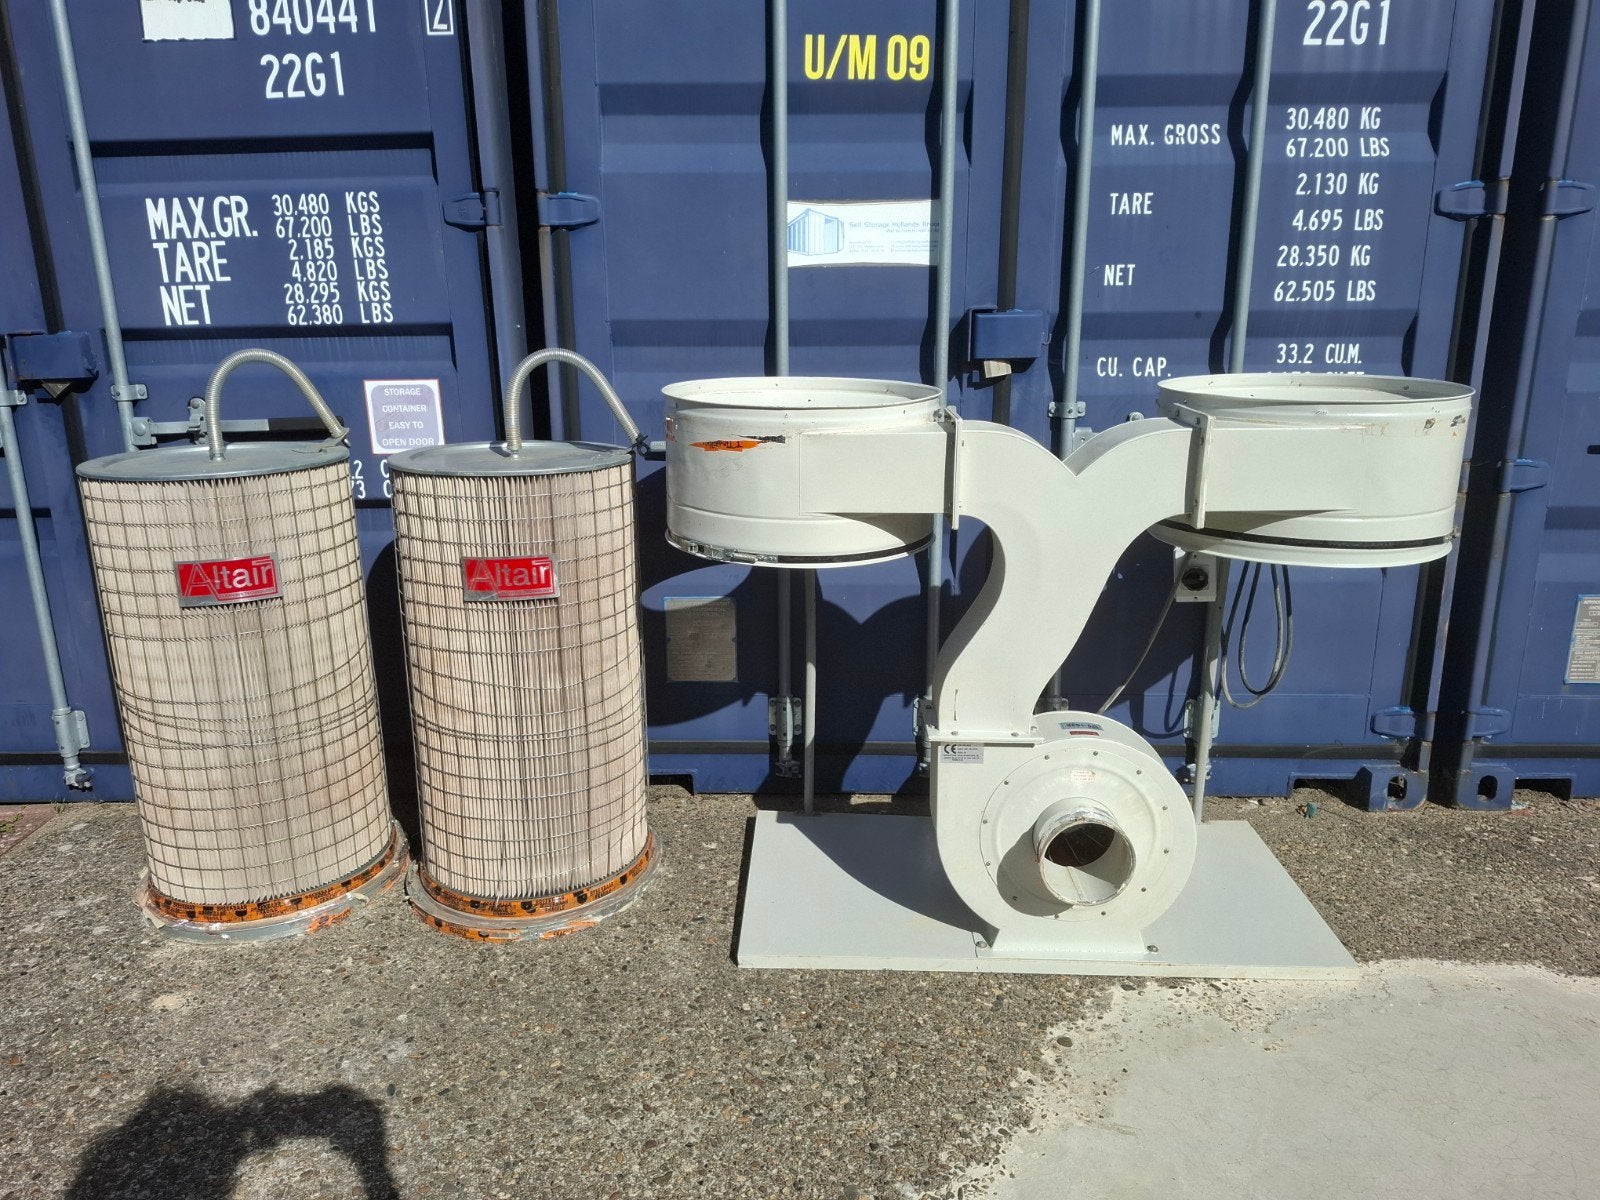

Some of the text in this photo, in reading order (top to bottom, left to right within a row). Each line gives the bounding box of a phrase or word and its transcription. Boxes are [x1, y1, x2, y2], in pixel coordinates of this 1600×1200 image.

[248, 0, 376, 36] 840441
[1303, 0, 1391, 46] 22G1
[804, 34, 930, 81] U/M 09
[260, 51, 345, 99] 22G1
[1285, 106, 1382, 130] 30,480 KG
[1111, 123, 1221, 146] MAX. GROSS
[1285, 137, 1390, 158] 67,200 LBS
[1295, 172, 1380, 195] 2,130 KG
[345, 191, 380, 214] KGS
[1110, 192, 1154, 215] TARE
[145, 195, 259, 240] MAX.GR.
[348, 214, 383, 236] LBS
[1292, 208, 1384, 231] 4,695 LBS
[351, 236, 386, 258] KGS
[1276, 244, 1371, 267] 28,350 KG
[153, 240, 232, 283] TARE
[353, 259, 389, 282] LBS
[1103, 263, 1136, 286] NET
[356, 281, 391, 302] KGS
[1273, 279, 1377, 302] 62,505 LBS
[159, 284, 212, 326] NET
[359, 302, 394, 324] LBS
[1276, 343, 1362, 364] 33.2 CU.M.
[1096, 356, 1172, 377] CU. CAP.
[384, 388, 421, 396] STORAGE
[382, 404, 427, 413] CONTAINER
[388, 421, 424, 429] EASY TO
[382, 437, 435, 447] OPEN DOOR
[184, 558, 273, 599] Altair
[469, 559, 552, 597] Altair
